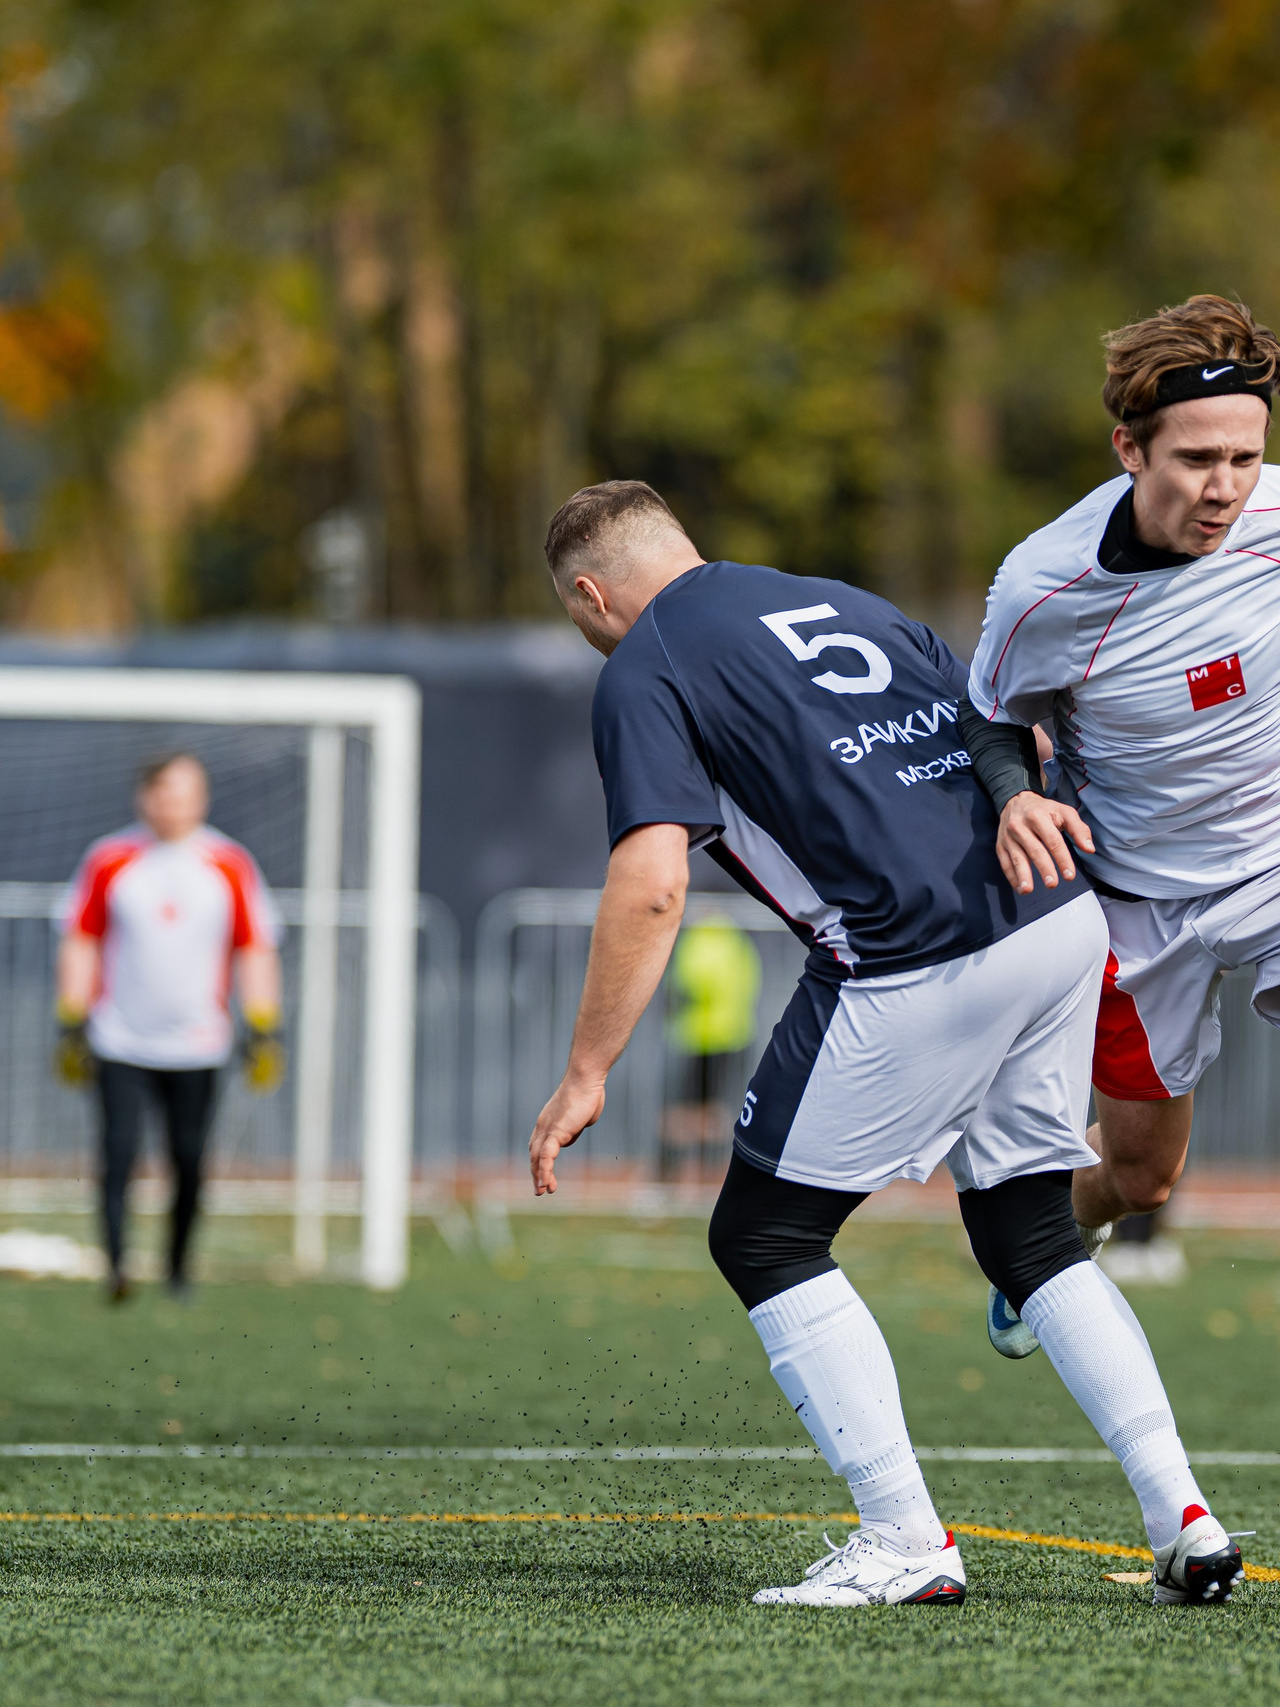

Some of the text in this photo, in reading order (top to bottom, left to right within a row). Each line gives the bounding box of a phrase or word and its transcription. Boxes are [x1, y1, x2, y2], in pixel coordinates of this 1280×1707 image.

[759, 602, 892, 694] 5
[895, 750, 972, 787] МОСКВ
[740, 1090, 758, 1127] 5
